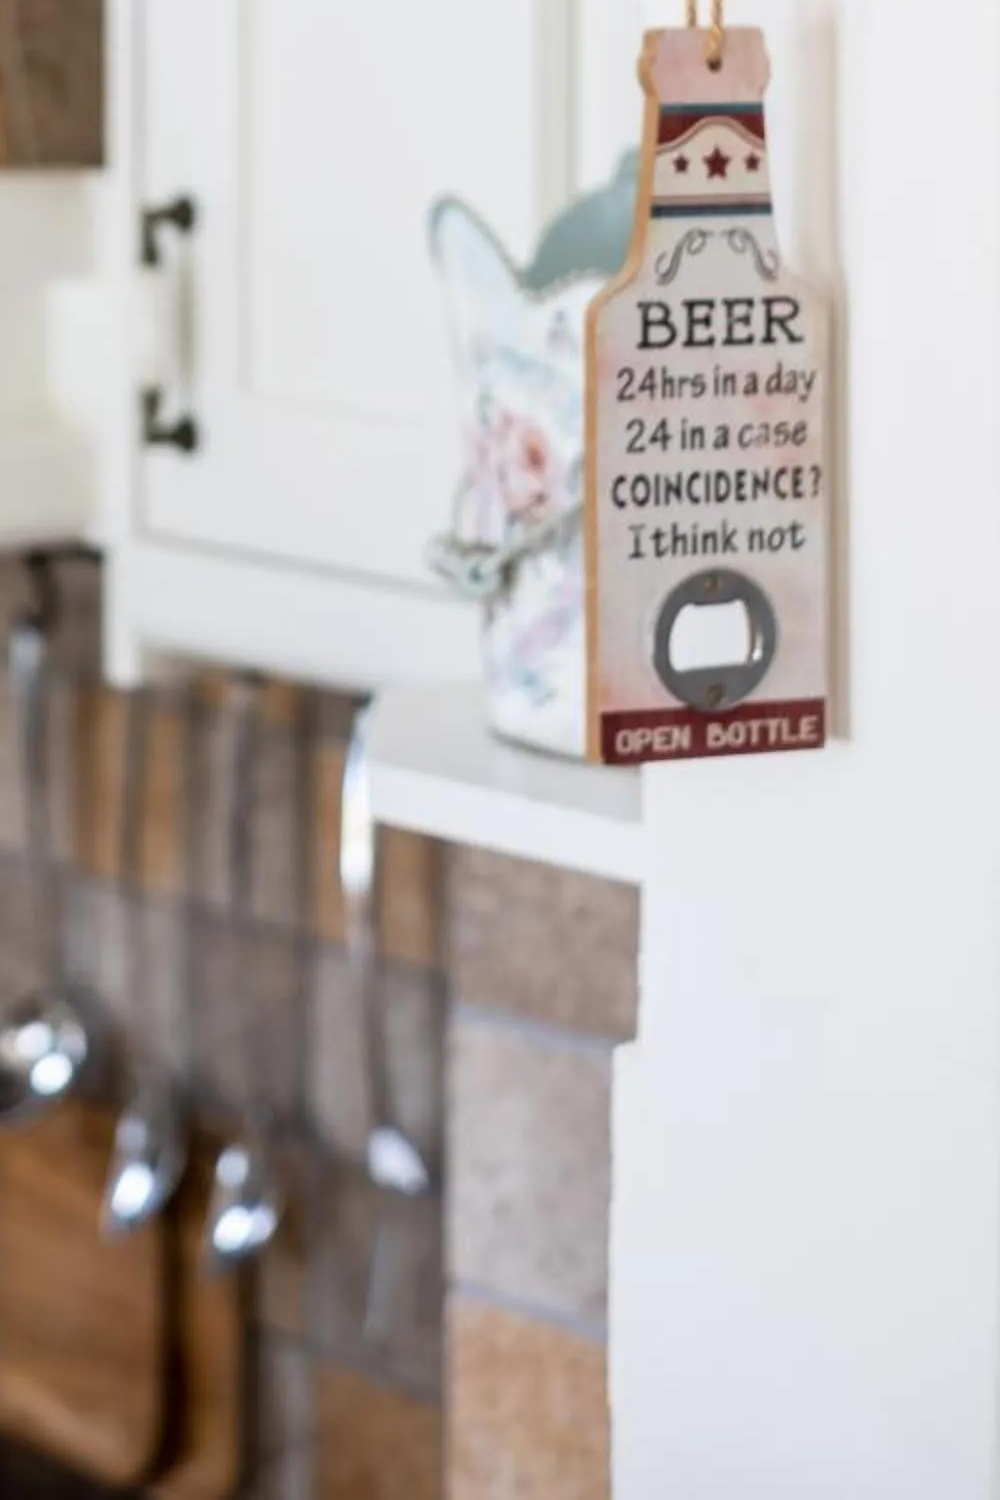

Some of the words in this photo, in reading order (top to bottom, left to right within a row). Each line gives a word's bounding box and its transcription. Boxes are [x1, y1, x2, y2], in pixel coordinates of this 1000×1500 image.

[636, 297, 804, 350] BEER
[616, 365, 707, 402] 24hrs
[713, 364, 739, 397] in
[745, 372, 760, 394] a
[766, 360, 817, 402] day
[626, 418, 673, 454] 24
[680, 418, 706, 450] in
[714, 426, 730, 448] a
[738, 418, 808, 448] case
[611, 463, 822, 508] COINCIDENCE?
[627, 524, 646, 559] I
[650, 520, 740, 556] think
[747, 518, 806, 552] not
[615, 722, 692, 753] OPEN
[704, 715, 819, 747] BOTTLE
